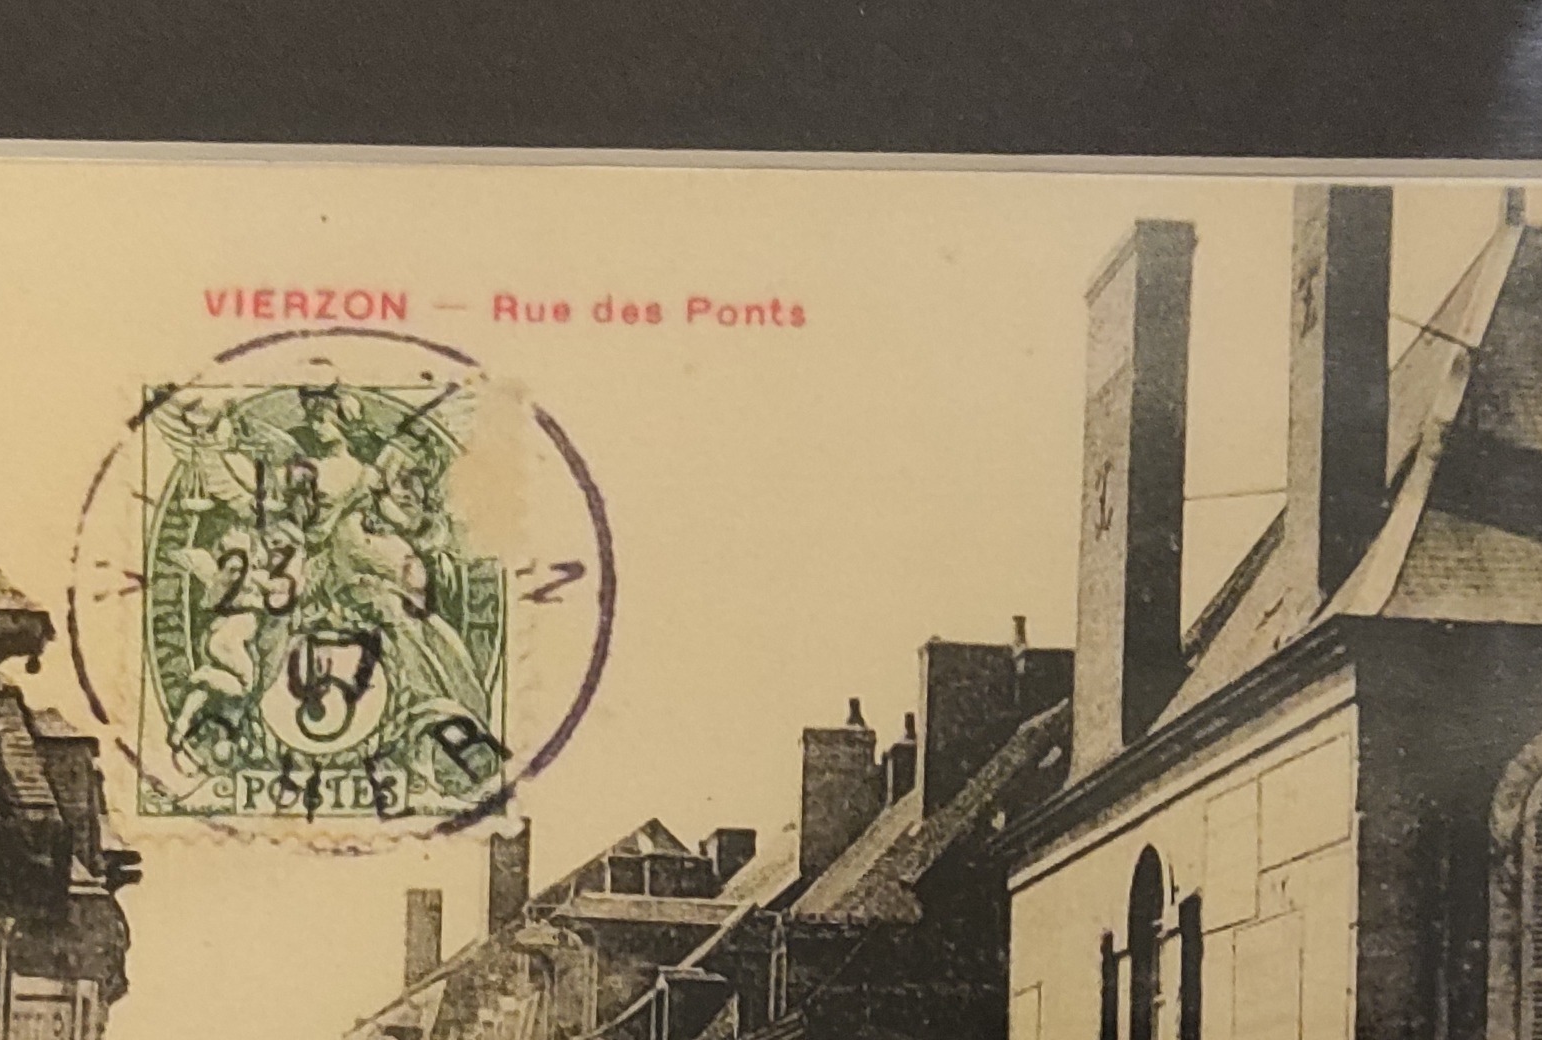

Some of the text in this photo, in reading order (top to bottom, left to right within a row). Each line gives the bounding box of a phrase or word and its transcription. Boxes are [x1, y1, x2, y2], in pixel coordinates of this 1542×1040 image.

[203, 288, 410, 322] VIERZON
[492, 293, 572, 324] Rue
[592, 294, 663, 326] des
[687, 297, 807, 328] Ponts
